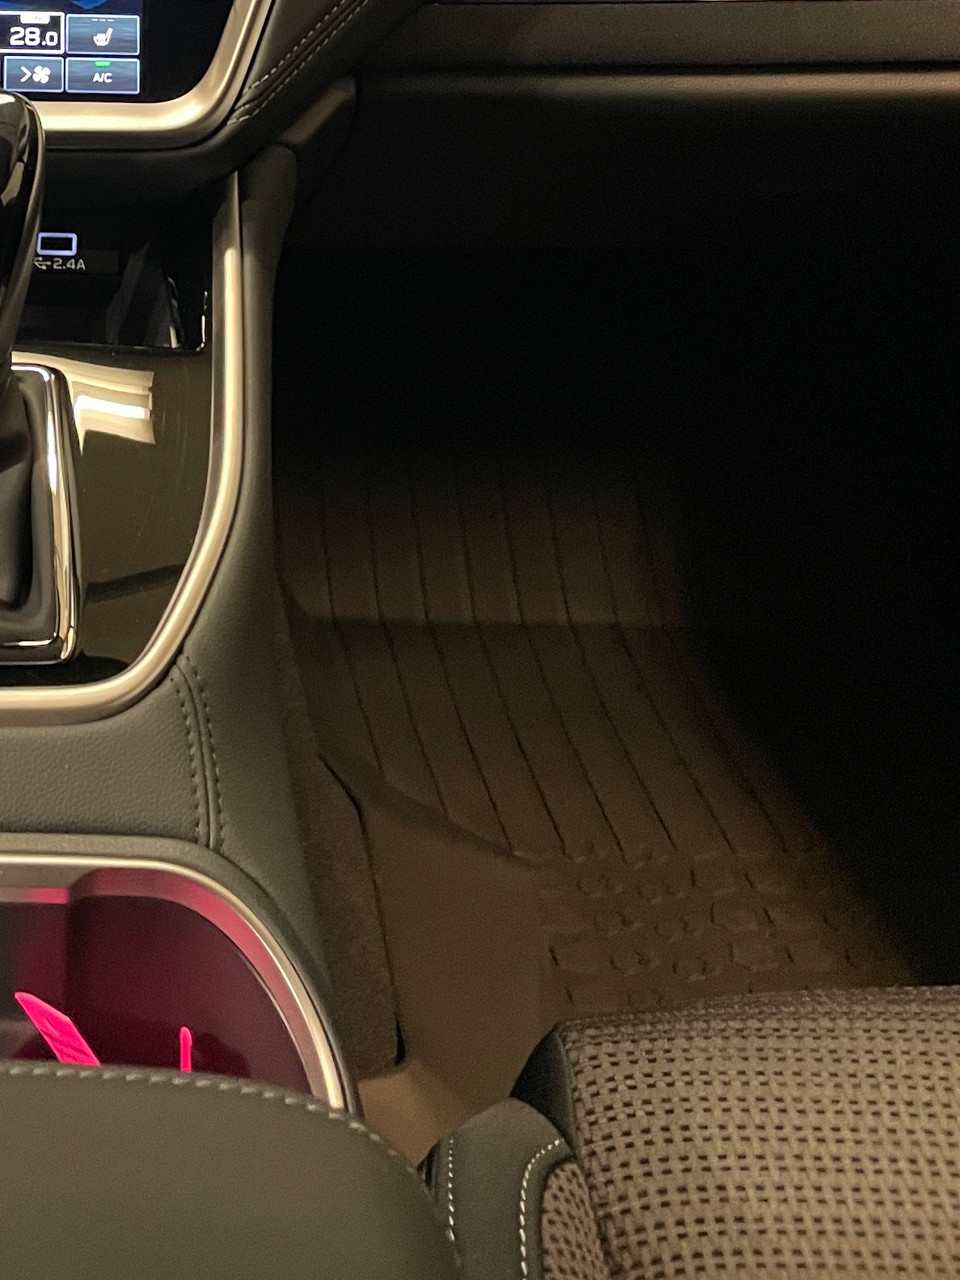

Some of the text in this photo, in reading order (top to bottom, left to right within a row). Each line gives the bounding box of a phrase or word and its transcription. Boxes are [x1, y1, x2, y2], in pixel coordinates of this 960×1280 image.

[10, 27, 58, 46] 28.0
[93, 72, 112, 83] A/C
[52, 258, 86, 270] 2.4A
